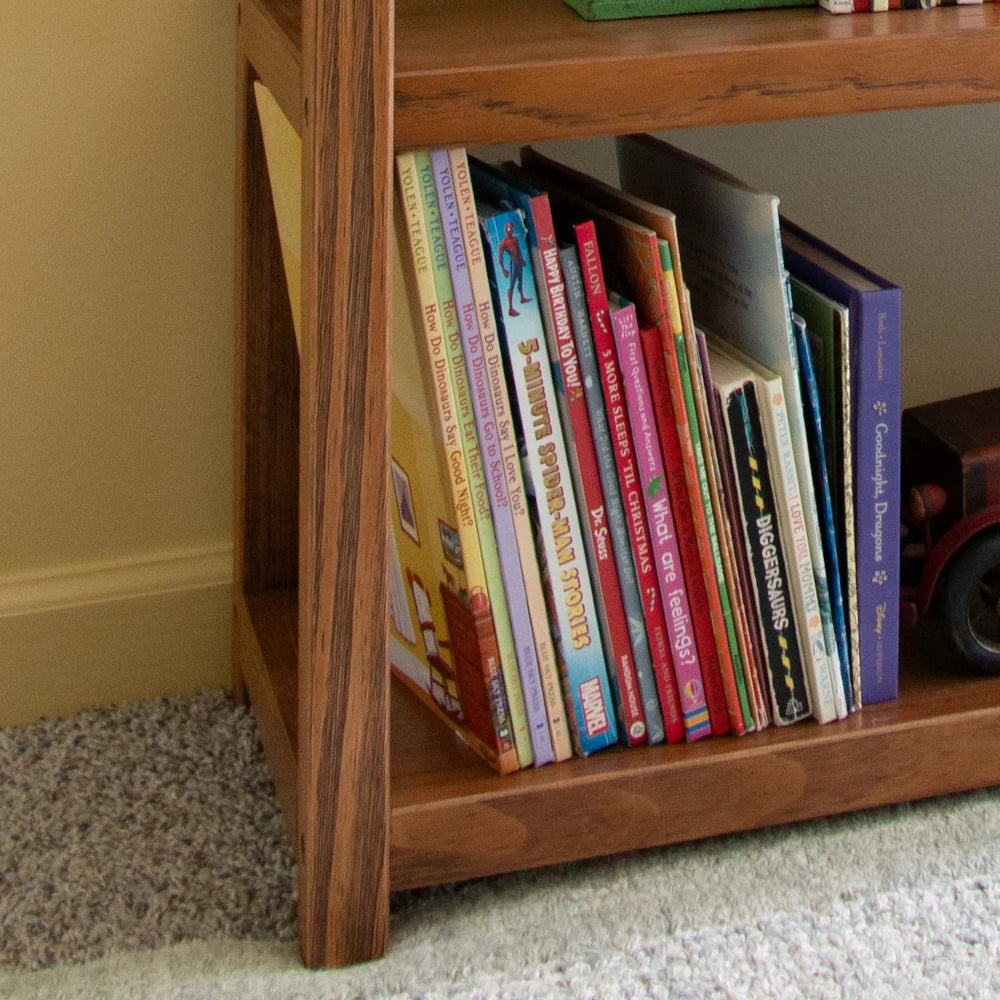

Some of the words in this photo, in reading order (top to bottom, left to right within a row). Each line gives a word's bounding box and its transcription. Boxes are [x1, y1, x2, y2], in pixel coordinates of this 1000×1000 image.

[402, 167, 417, 211] YOLEN
[410, 222, 428, 274] TEAGUE
[420, 165, 437, 208] YOLEN
[430, 219, 447, 271] TEAGUE
[440, 168, 455, 210] YOLEN
[448, 219, 466, 270] TEAGUE
[456, 162, 471, 204] YOLEN
[465, 213, 481, 266] TEAGUE
[544, 248, 560, 283] HAPPY
[584, 240, 600, 296] FALLON
[425, 303, 438, 332] How
[442, 300, 454, 328] How
[462, 303, 474, 331] How
[479, 301, 490, 329] How
[551, 283, 572, 340] BIRTHDAY
[430, 336, 442, 356] Do
[448, 333, 459, 351] Do
[468, 335, 479, 354] Do
[484, 333, 495, 352] Do
[602, 349, 611, 358] 5
[628, 343, 638, 368] First
[434, 359, 452, 422] Dinosaurs
[452, 355, 470, 418] Dinosaurs
[472, 357, 489, 419] Dinosaurs
[488, 355, 505, 416] Dinosaurs
[604, 362, 620, 402] MORE
[630, 367, 646, 412] Questions
[446, 424, 457, 447] Say
[463, 421, 475, 442] Eat
[484, 422, 494, 441] Go
[499, 420, 511, 441] Say
[613, 403, 630, 457] SLEEPS
[640, 413, 650, 430] and
[776, 412, 788, 448] PETER
[450, 450, 465, 485] Good
[468, 445, 480, 480] Their
[487, 444, 496, 457] to
[503, 453, 517, 483] Love
[644, 431, 656, 472] Answers
[872, 422, 889, 499] Goodnight,
[474, 483, 490, 520] Food?
[490, 460, 508, 508] School?
[510, 486, 525, 516] You?
[517, 338, 552, 440] 5-MINUTE
[538, 442, 576, 566] SPIDER-MAN
[560, 567, 591, 650] STORIES
[456, 488, 474, 527] Night?
[591, 505, 603, 528] Dr.
[652, 498, 672, 545] What
[791, 503, 804, 531] LOVE
[594, 527, 608, 560] Seuss
[628, 491, 650, 574] CHRISTMAS
[795, 532, 809, 558] YOU
[871, 502, 888, 562] Dragons
[661, 552, 676, 584] are
[756, 514, 790, 631] DIGGERSAURS
[799, 558, 818, 613] MOMMY
[668, 589, 696, 666] feelings?
[621, 654, 632, 690] RANDOM
[628, 690, 639, 717] HOUSE
[819, 665, 832, 706] WARNE
[580, 678, 608, 736] MARVEL
